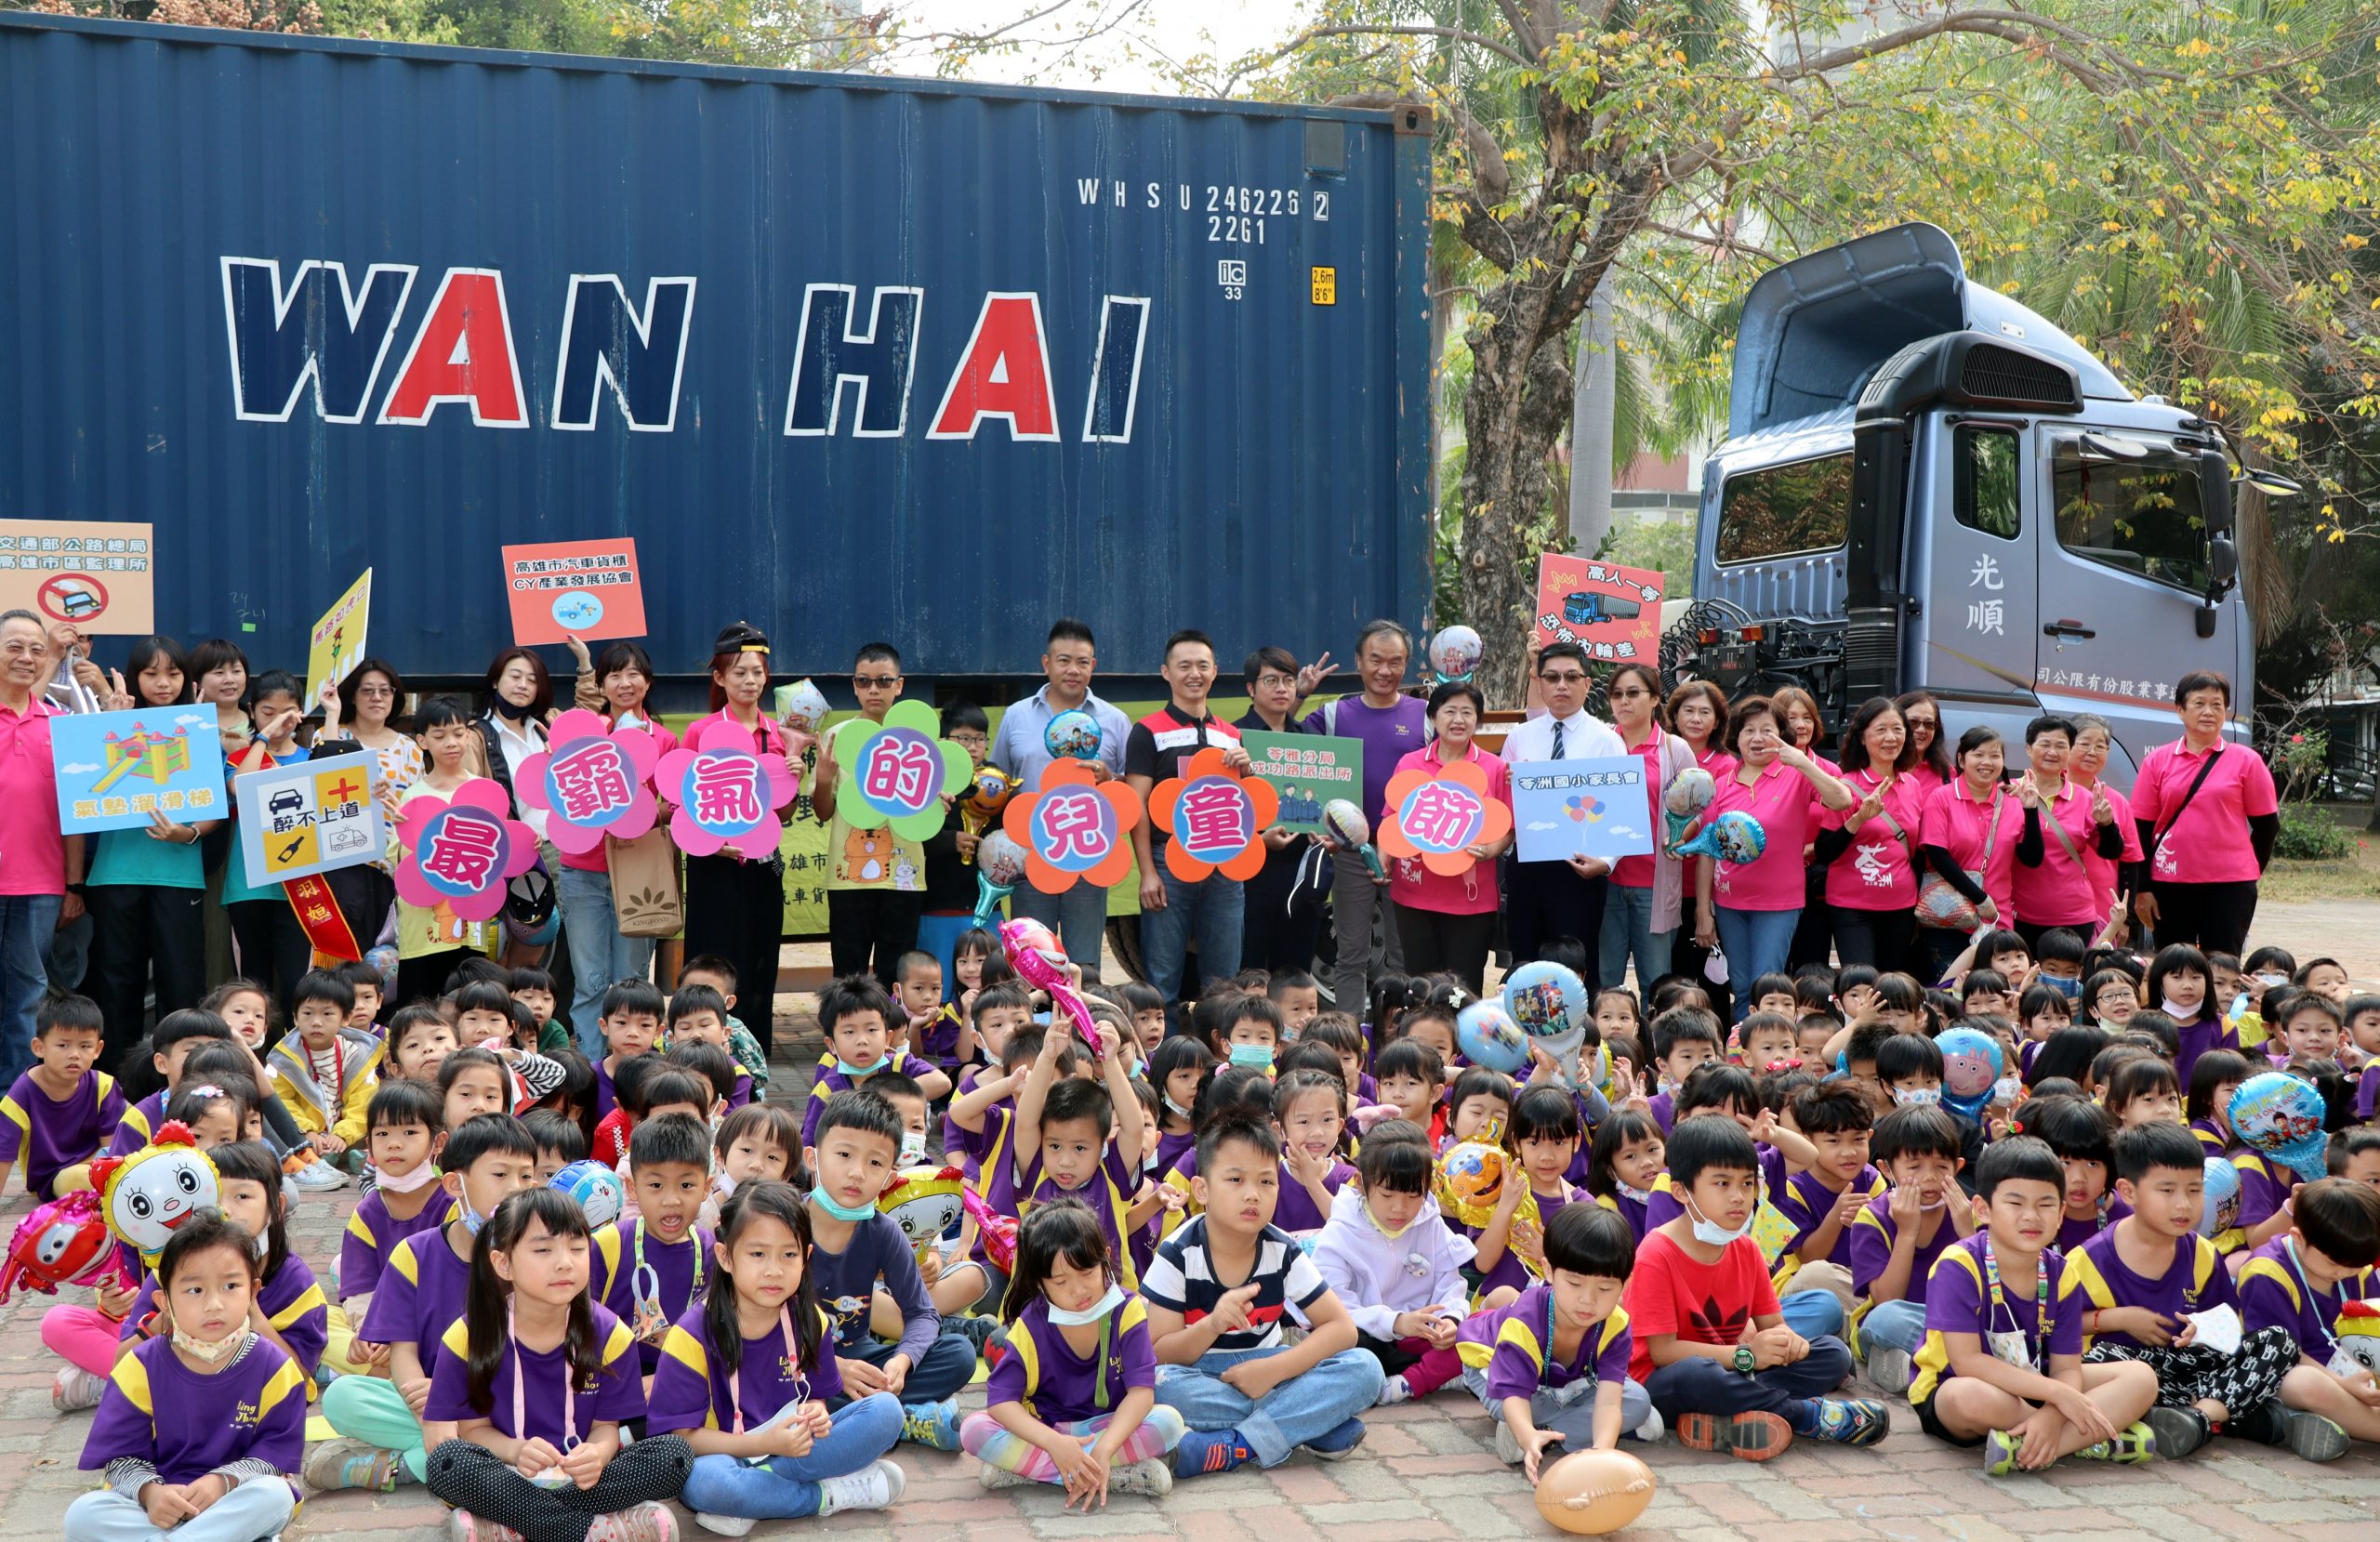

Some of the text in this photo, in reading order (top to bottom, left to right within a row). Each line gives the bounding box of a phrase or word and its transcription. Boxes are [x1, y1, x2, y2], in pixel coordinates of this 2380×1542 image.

[1314, 192, 1328, 220] 2
[1209, 216, 1264, 244] 22G1
[1224, 286, 1242, 300] 33
[220, 256, 1151, 444] WAN HAI
[0, 534, 148, 553] 交通部公路總局
[0, 554, 148, 572] 高雄市區監理所
[514, 553, 628, 574] 高雄市汽車貨櫃
[513, 571, 633, 591] CY產業發展協會
[1587, 564, 1662, 603] 高人一等
[1966, 553, 2003, 637] 光順
[1251, 761, 1353, 782] 成功路派出所
[1267, 747, 1336, 766] 苓雅分局
[551, 742, 633, 821] 霸
[864, 735, 935, 811] 的
[1518, 770, 1640, 790] 苓洲國小家長會
[73, 788, 215, 819] 氣墊溜滑梯
[692, 755, 763, 825] 氣
[272, 800, 360, 834] 醉不上道
[1040, 793, 1109, 862] 兒
[1183, 784, 1250, 852] 童
[1401, 782, 1483, 850] 節
[422, 813, 501, 891] 最
